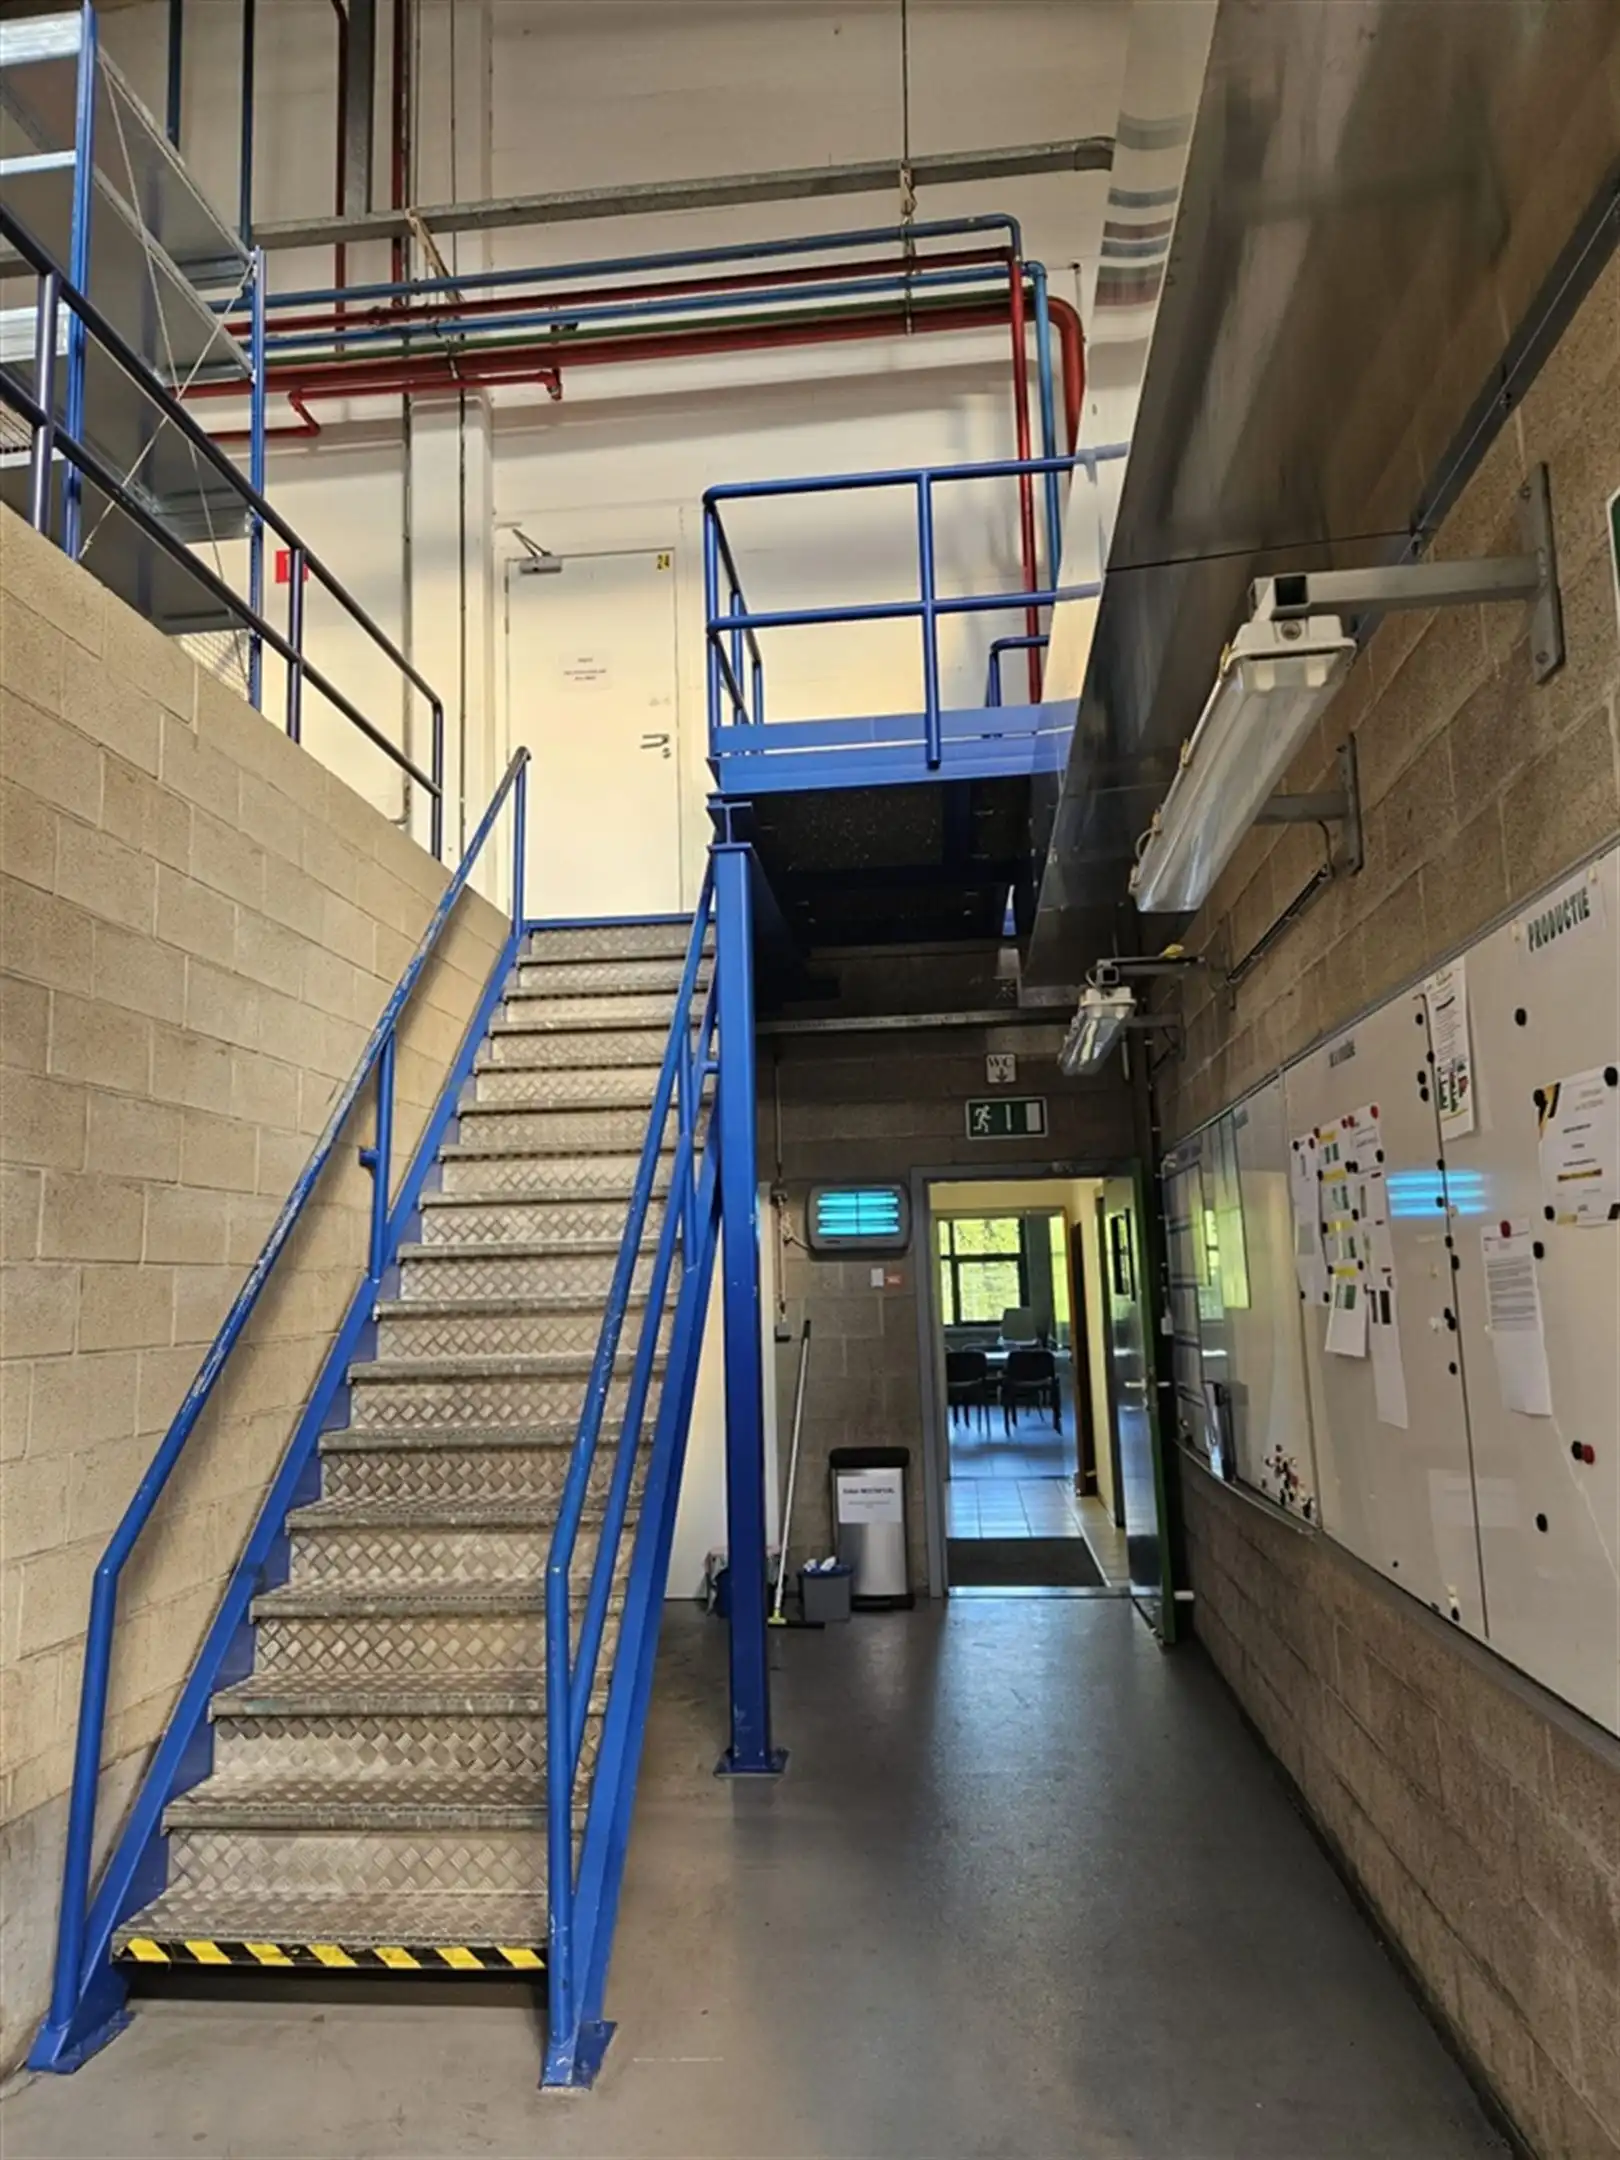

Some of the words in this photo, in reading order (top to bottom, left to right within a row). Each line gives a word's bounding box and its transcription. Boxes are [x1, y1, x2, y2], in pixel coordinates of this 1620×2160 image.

[657, 554, 670, 570] 24
[1528, 886, 1590, 953] PRODUCTIE
[989, 1056, 1014, 1068] WC
